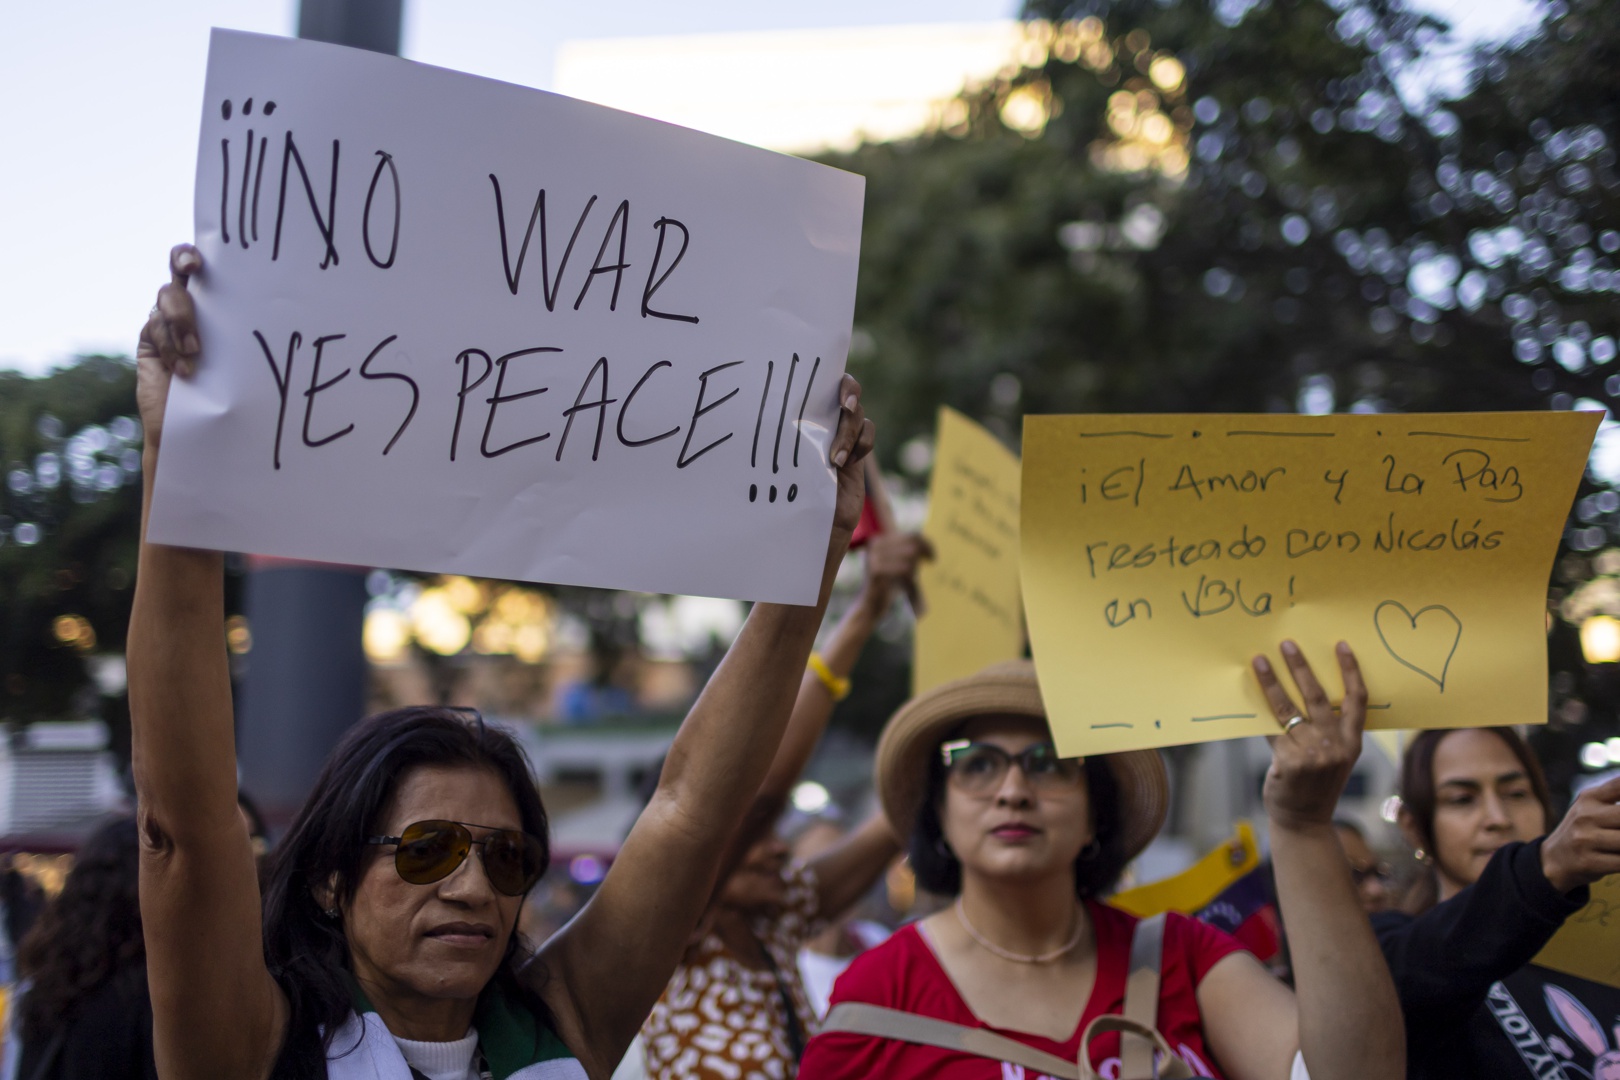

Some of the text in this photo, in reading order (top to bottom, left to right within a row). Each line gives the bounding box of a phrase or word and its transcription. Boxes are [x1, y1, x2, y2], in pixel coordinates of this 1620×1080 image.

[489, 173, 699, 324] WAR
[252, 330, 820, 503] YES PEACE!!!
[1168, 464, 1286, 501] Amor
[1442, 449, 1523, 503] Paz
[1086, 524, 1267, 579] resteado
[1374, 512, 1504, 553] Nicolás
[1104, 598, 1152, 628] en
